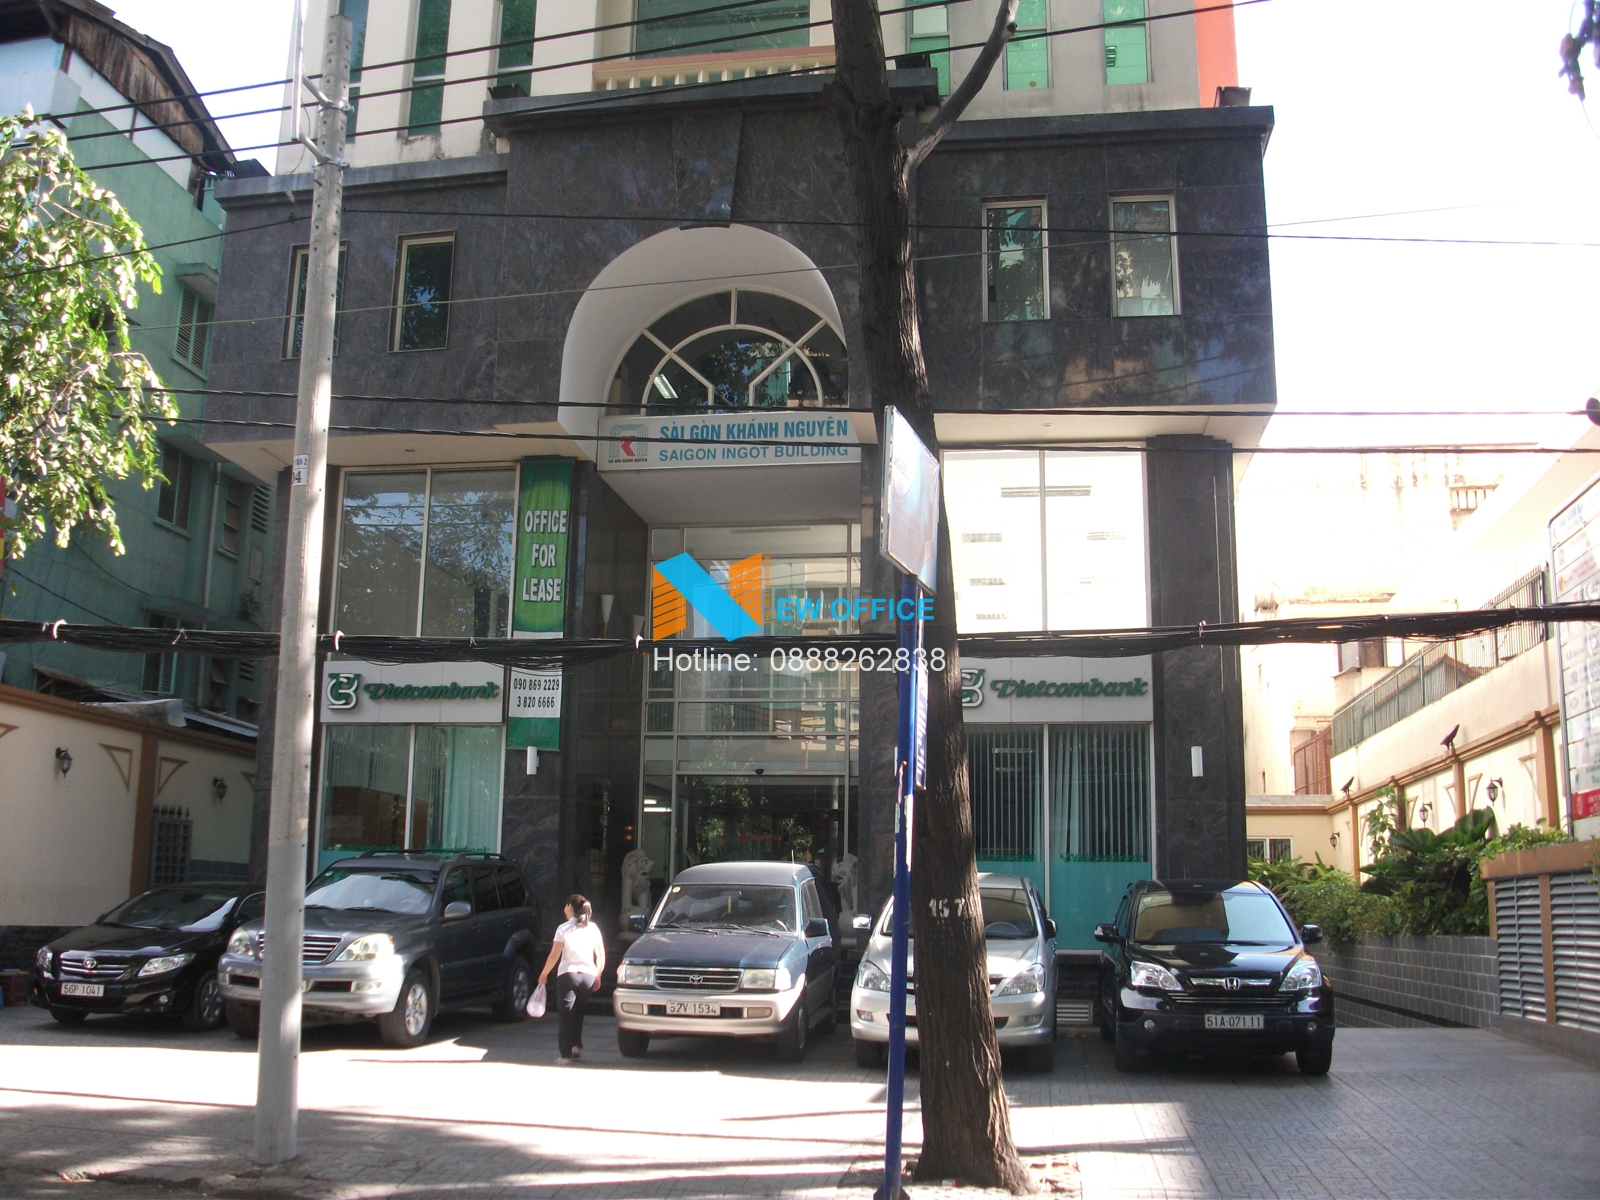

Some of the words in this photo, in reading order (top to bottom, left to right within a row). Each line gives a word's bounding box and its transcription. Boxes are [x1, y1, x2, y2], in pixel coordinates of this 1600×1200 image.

[659, 421, 685, 440] SÀI
[690, 420, 721, 441] GÒN
[726, 418, 779, 440] KHÁNH
[784, 416, 848, 438] NGUYÊN
[659, 447, 717, 461] SAIGON
[721, 446, 770, 460] INGOT
[774, 445, 849, 459] BUILDING
[524, 510, 568, 534] OFFICE
[531, 543, 556, 567] FOR
[522, 577, 562, 602] LEASE
[363, 681, 500, 701] Vietcombank
[513, 678, 527, 691] 090
[528, 679, 542, 691] 869
[543, 678, 560, 691] 2229
[990, 677, 1149, 698] Vietcombank
[516, 696, 522, 708] 3
[523, 696, 536, 708] 820
[537, 696, 555, 708] 6666
